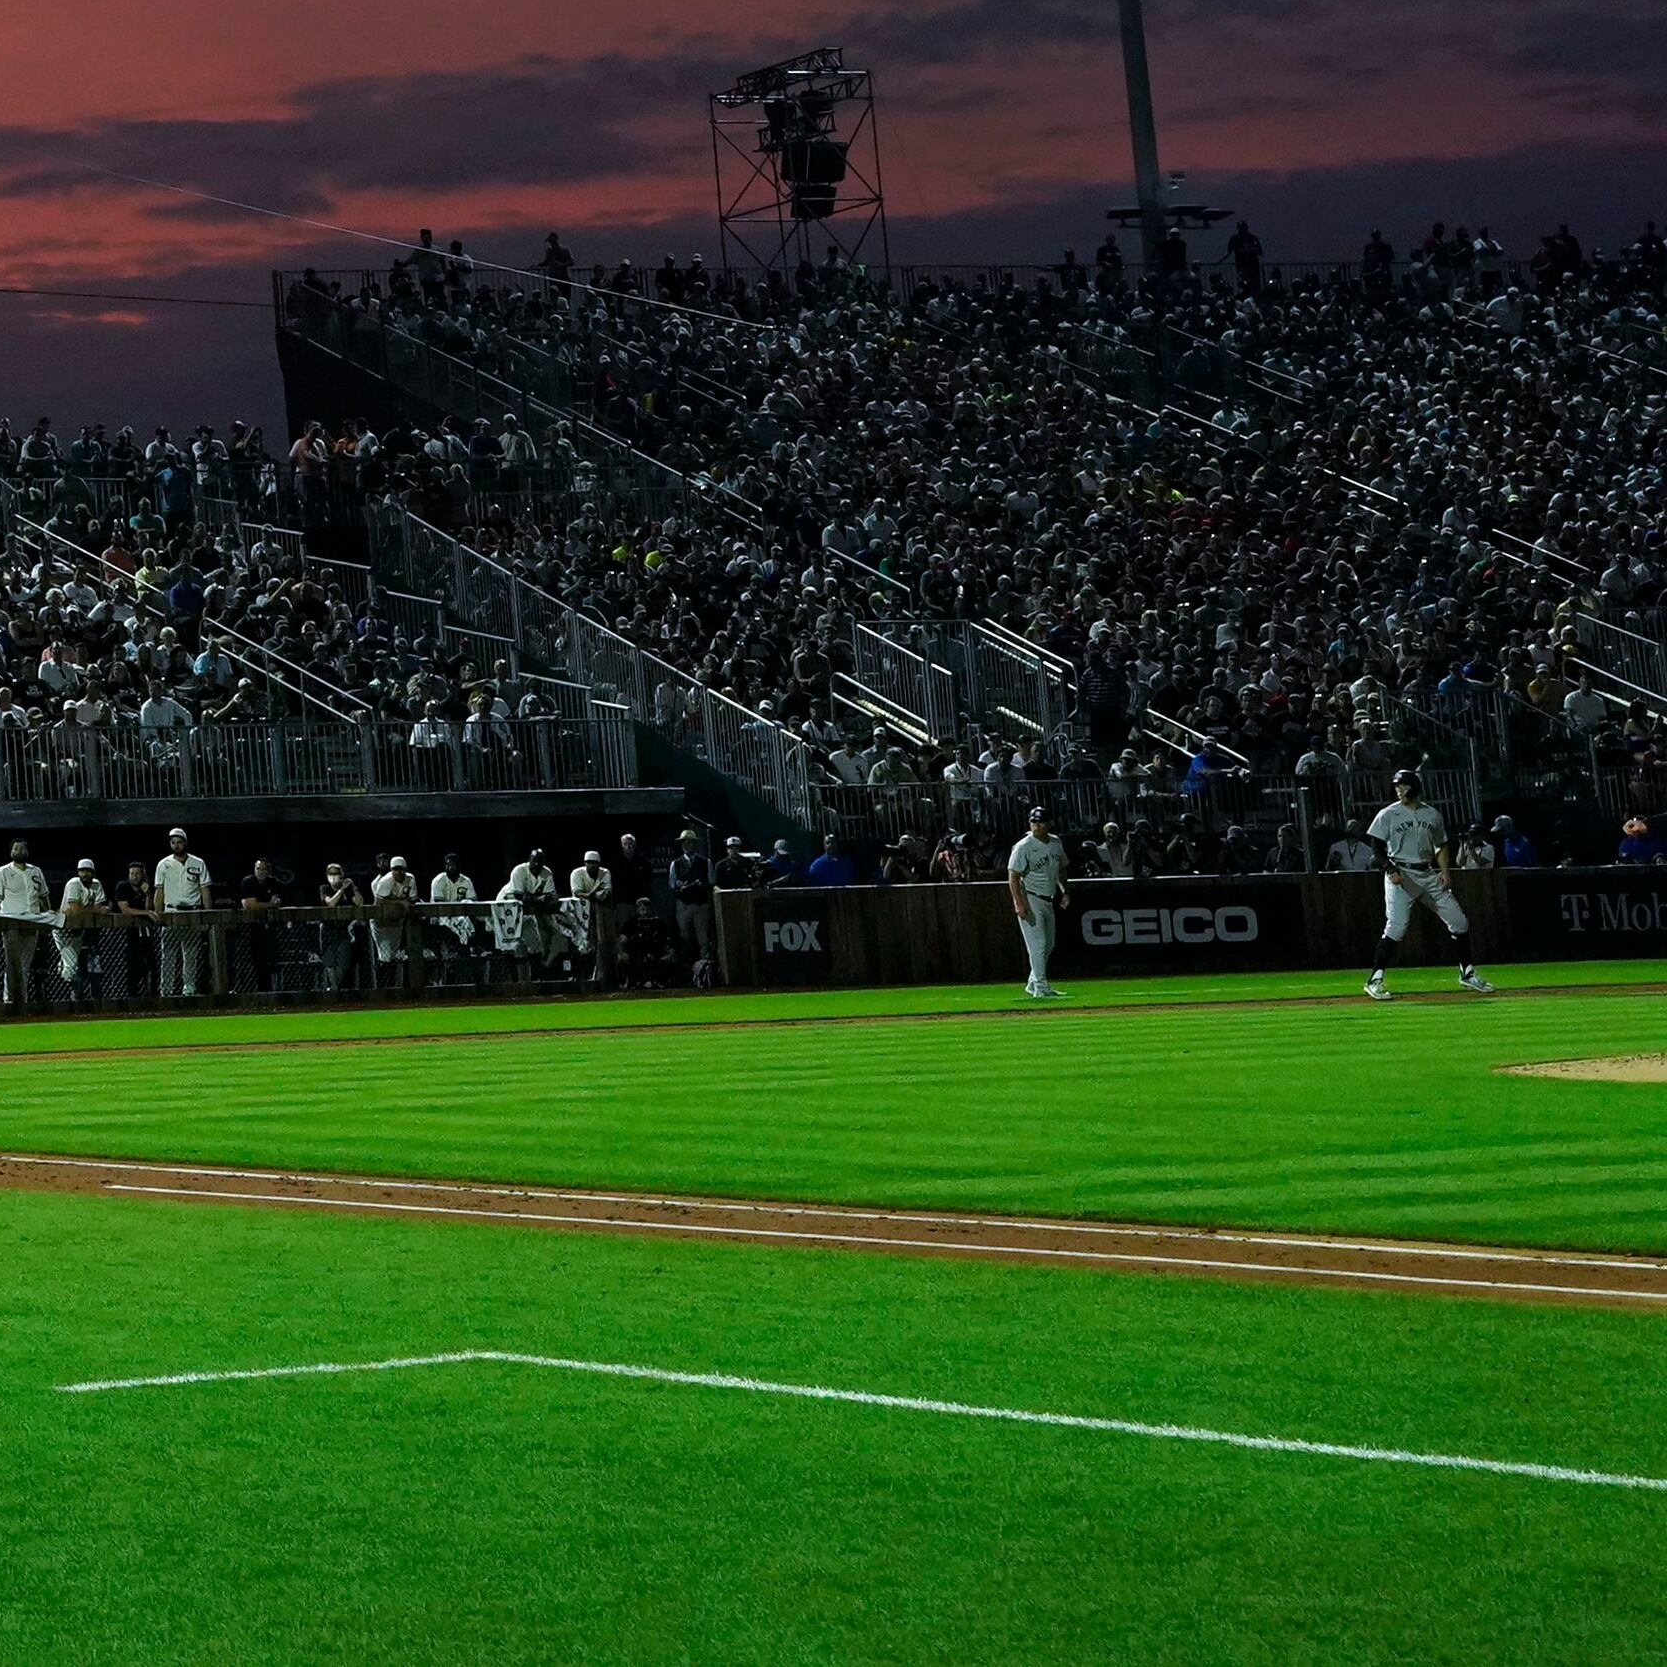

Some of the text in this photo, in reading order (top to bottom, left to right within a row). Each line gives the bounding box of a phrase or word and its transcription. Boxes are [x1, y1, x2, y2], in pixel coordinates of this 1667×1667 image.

[1395, 818, 1440, 834] NEW YOR
[763, 920, 823, 953] FOX
[1081, 906, 1259, 946] GEICO
